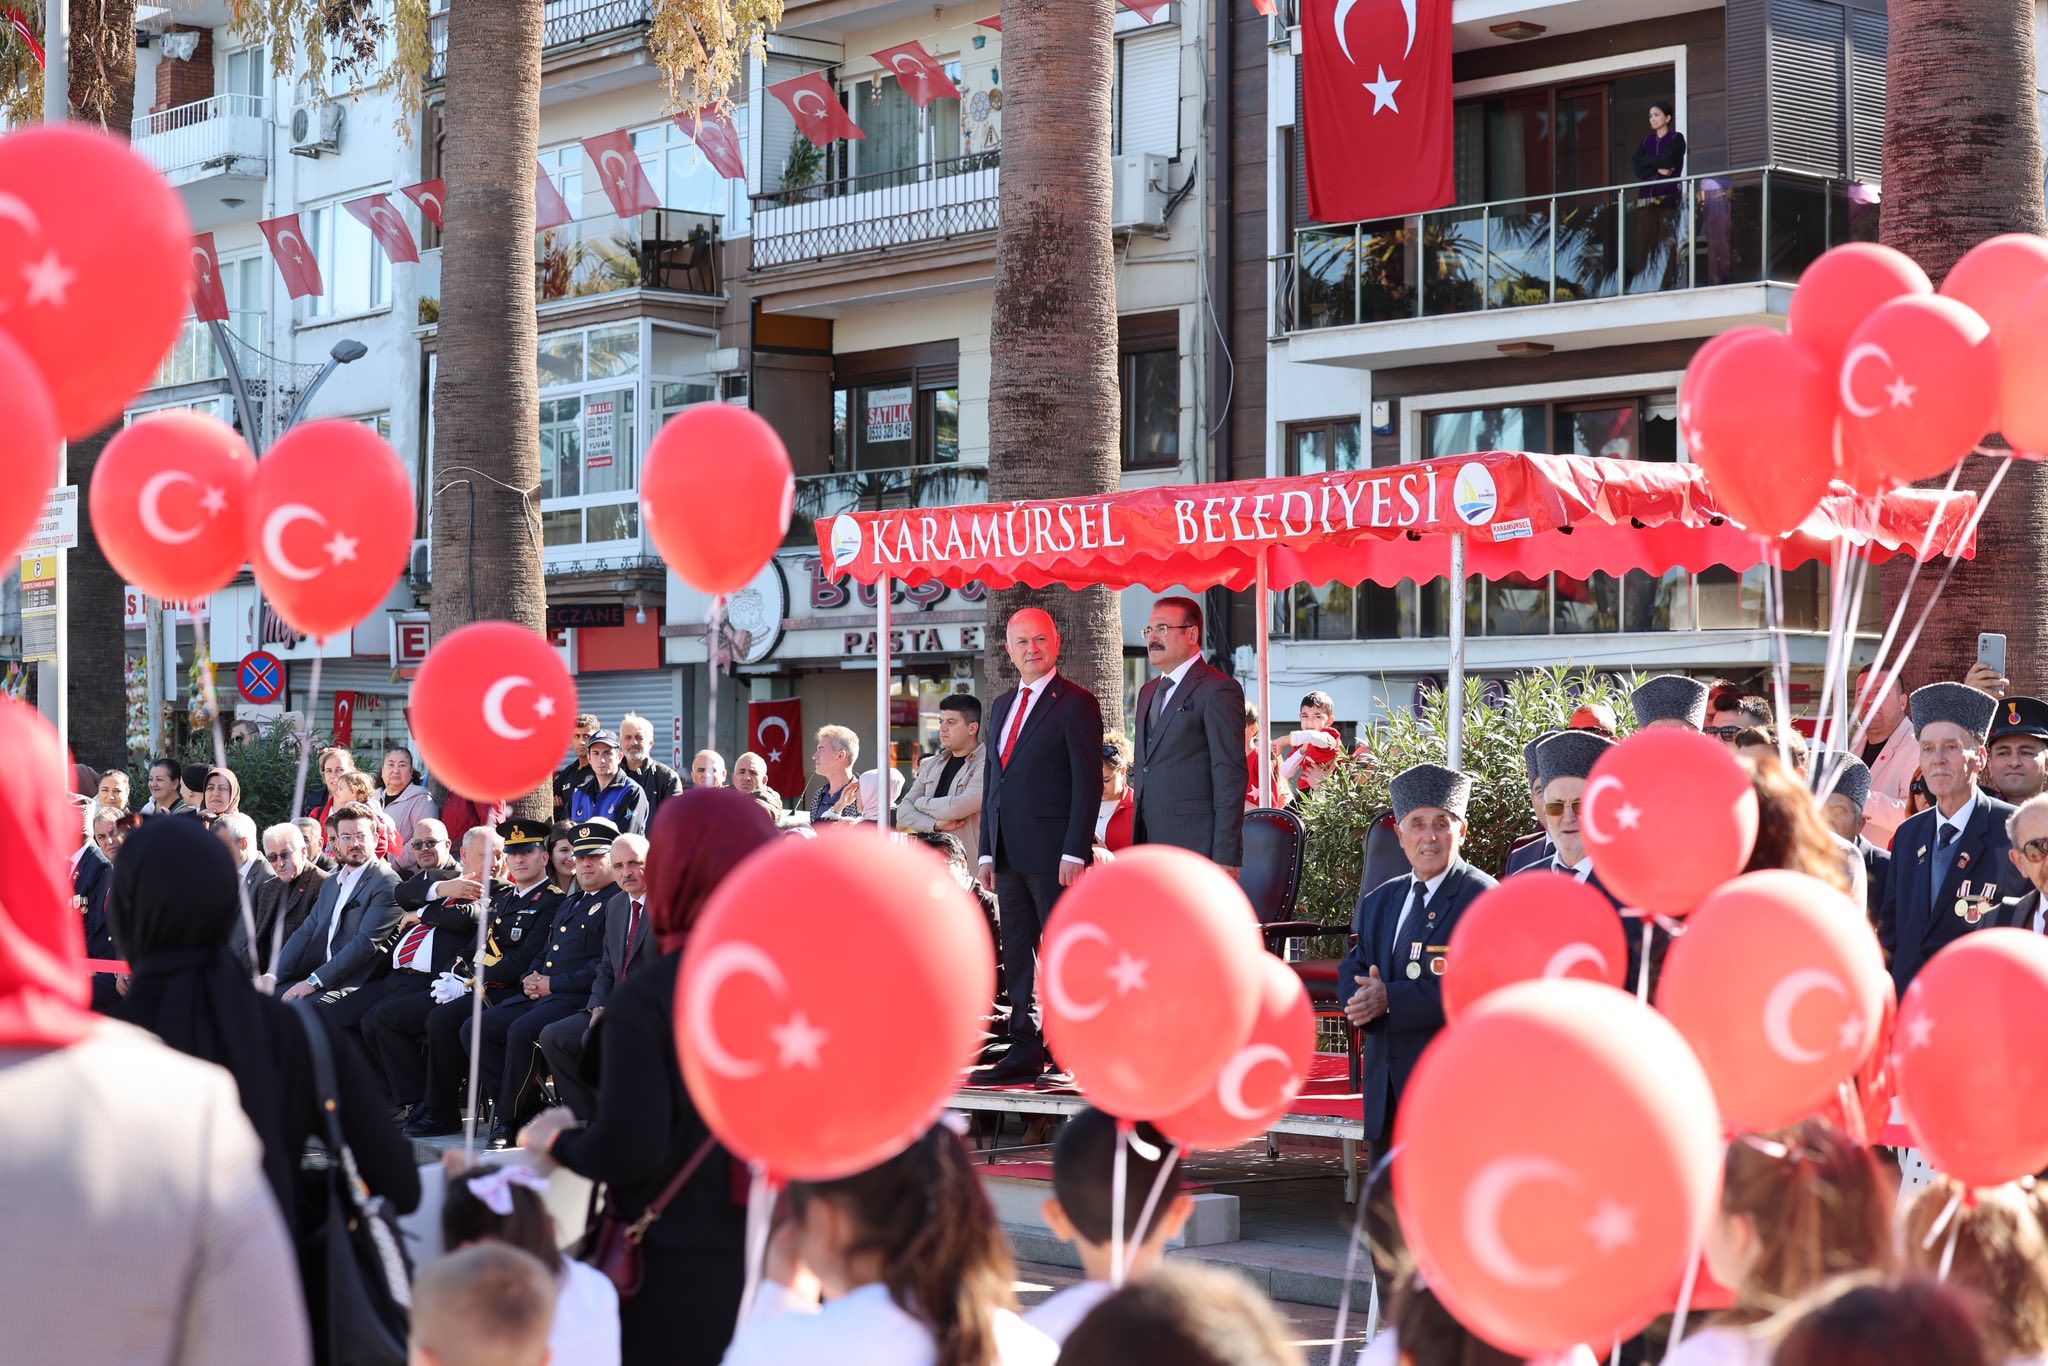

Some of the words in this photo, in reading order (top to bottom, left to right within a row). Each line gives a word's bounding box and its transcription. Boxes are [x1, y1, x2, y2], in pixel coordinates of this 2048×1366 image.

[869, 404, 910, 425] SATILIK
[869, 425, 882, 440] 0533
[883, 424, 893, 438] 320
[895, 423, 902, 437] 19
[903, 422, 910, 437] 46
[589, 440, 611, 449] YUVAM
[870, 500, 1125, 564] KARAMÜRSEL
[1174, 465, 1440, 545] BELEDİYESİ
[1493, 521, 1530, 532] KARAMÜRSEL
[125, 594, 137, 621] Ş
[548, 607, 621, 624] ECZANE
[403, 627, 425, 657] E
[843, 628, 943, 654] PASTA
[960, 626, 985, 650] E
